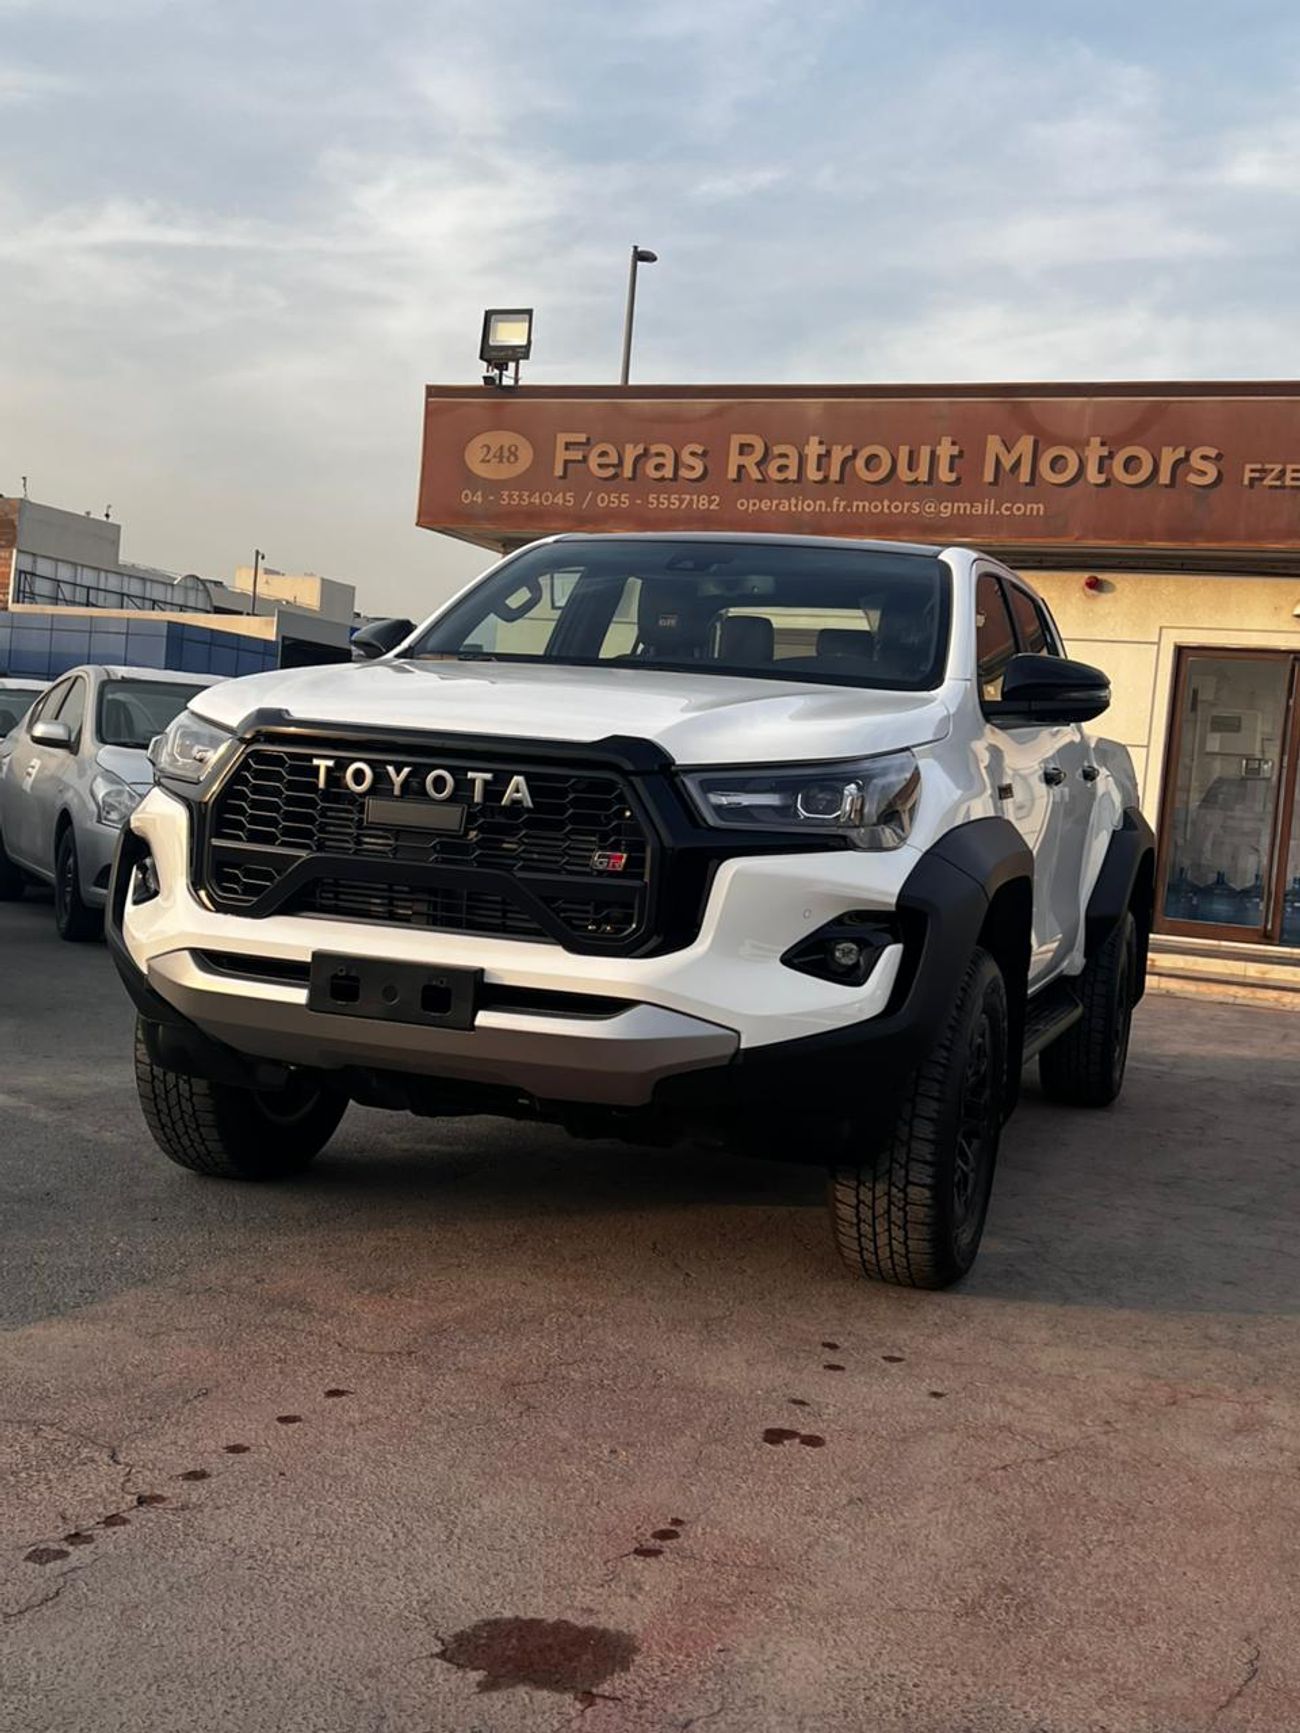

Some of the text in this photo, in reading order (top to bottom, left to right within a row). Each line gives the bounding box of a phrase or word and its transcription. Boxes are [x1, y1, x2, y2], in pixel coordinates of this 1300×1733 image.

[479, 443, 520, 464] 248
[553, 433, 1300, 489] Feras Ratrout Motors FZE
[461, 490, 483, 504] 04
[500, 491, 575, 507] 3334045
[597, 494, 630, 508] 055
[648, 495, 720, 510] 5557182
[736, 496, 1045, 517] operation.fr.motors@gmail.com
[312, 757, 534, 809] TOYOTA
